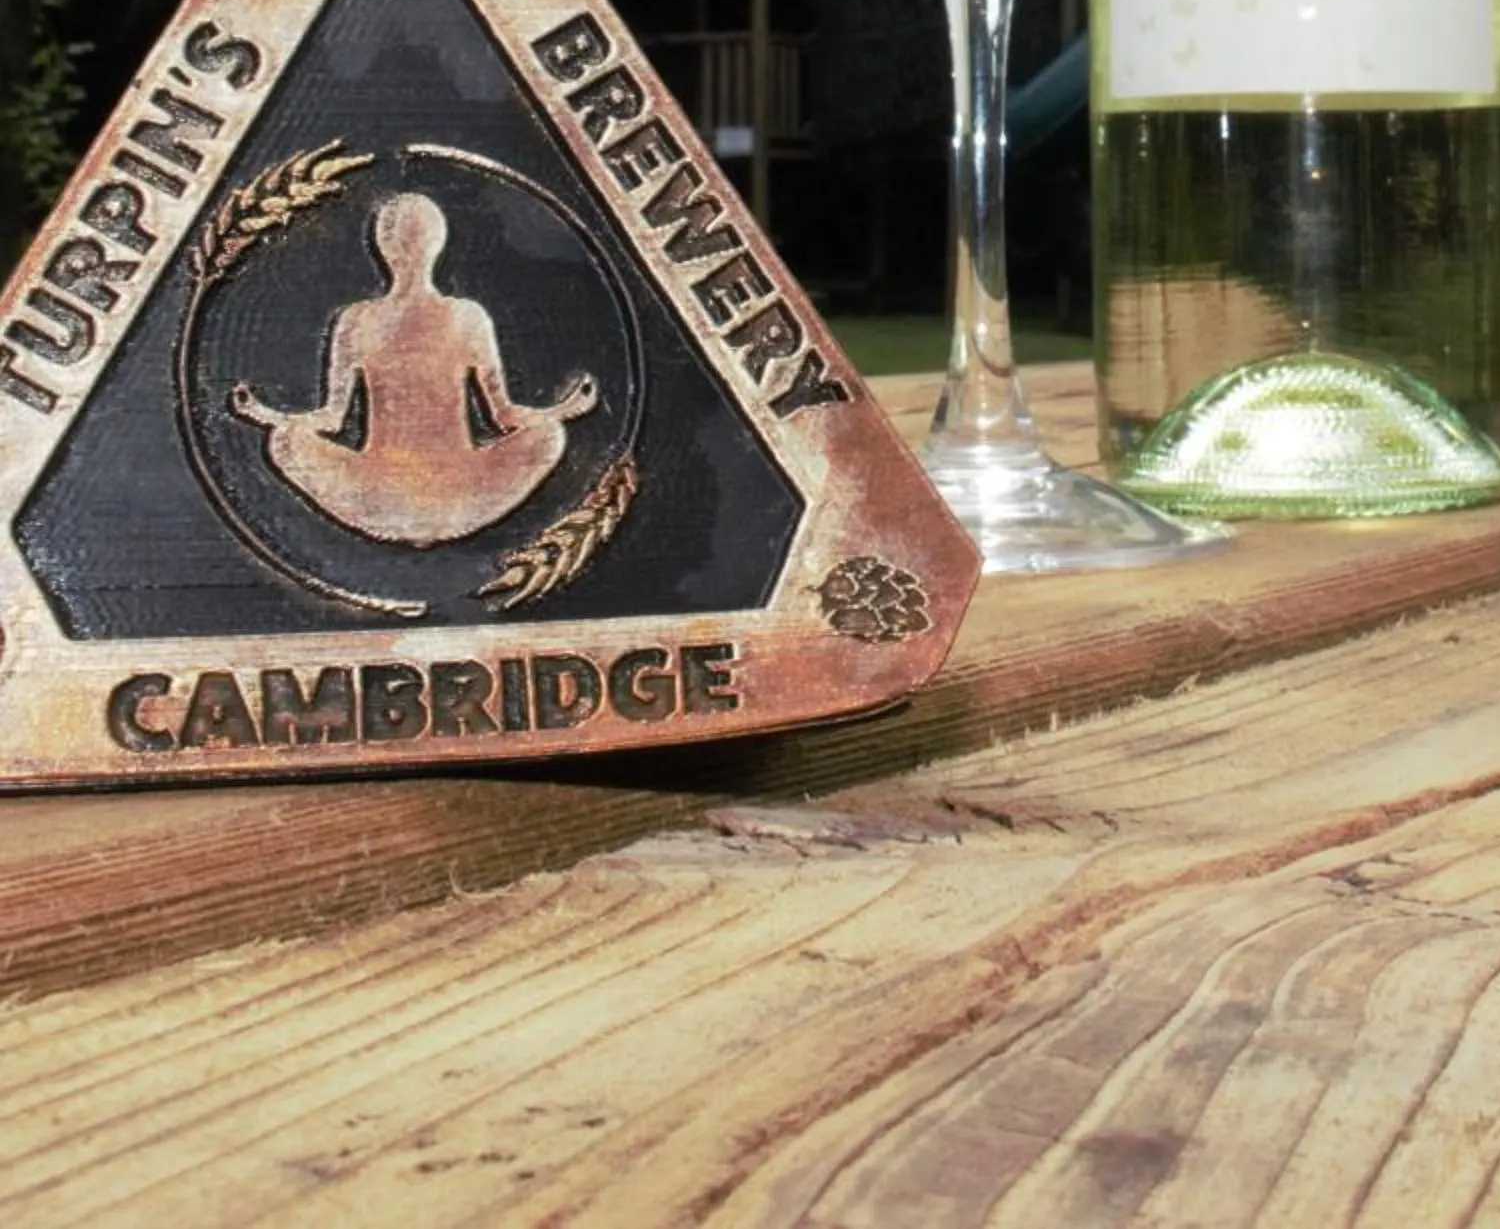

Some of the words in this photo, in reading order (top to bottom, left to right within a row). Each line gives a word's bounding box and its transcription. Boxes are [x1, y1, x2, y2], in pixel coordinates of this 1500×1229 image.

[0, 17, 264, 416] TURPIN'S
[530, 11, 849, 420] BREWERY
[105, 643, 743, 753] CAMBRIDGE
